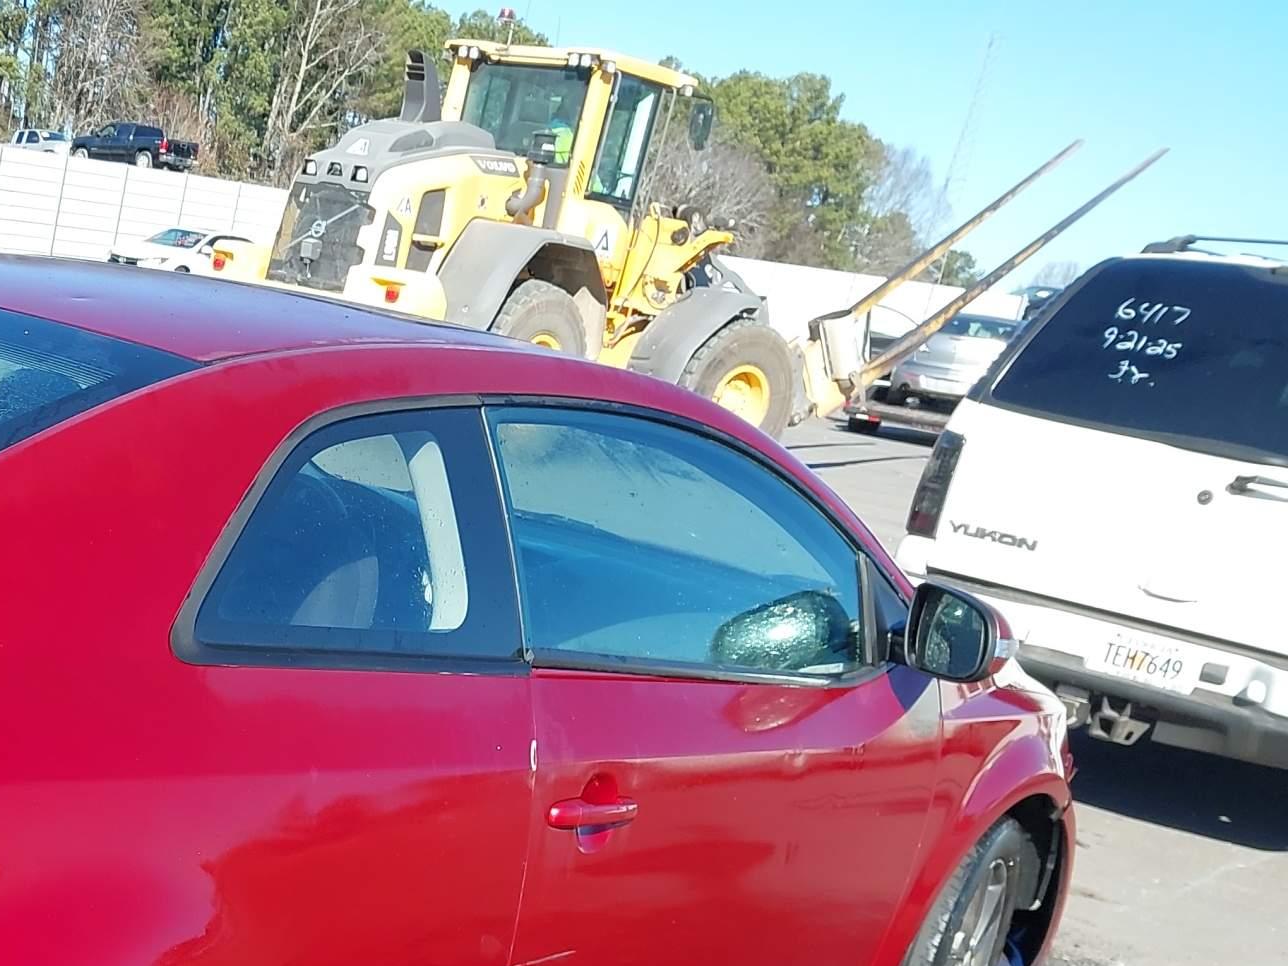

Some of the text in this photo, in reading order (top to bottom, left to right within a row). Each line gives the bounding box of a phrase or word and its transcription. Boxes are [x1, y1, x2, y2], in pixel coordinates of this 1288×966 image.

[1115, 297, 1191, 325] 6417
[949, 519, 1038, 551] YUKON
[1103, 642, 1183, 680] TEH7649
